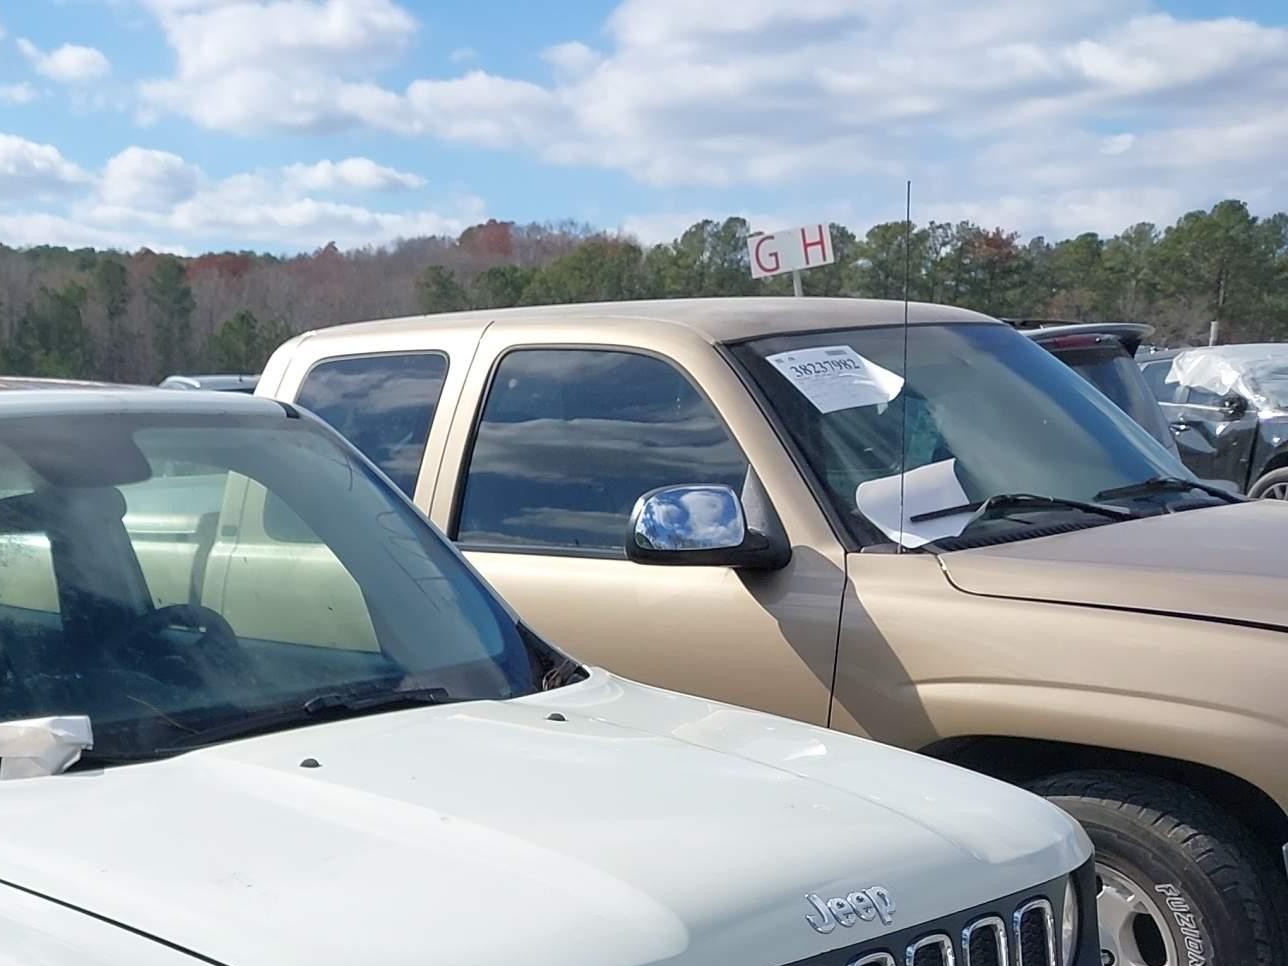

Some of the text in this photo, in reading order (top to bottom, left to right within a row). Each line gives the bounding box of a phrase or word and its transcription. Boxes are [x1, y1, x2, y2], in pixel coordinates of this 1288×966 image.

[755, 224, 827, 273] G H
[804, 886, 896, 935] Jeep
